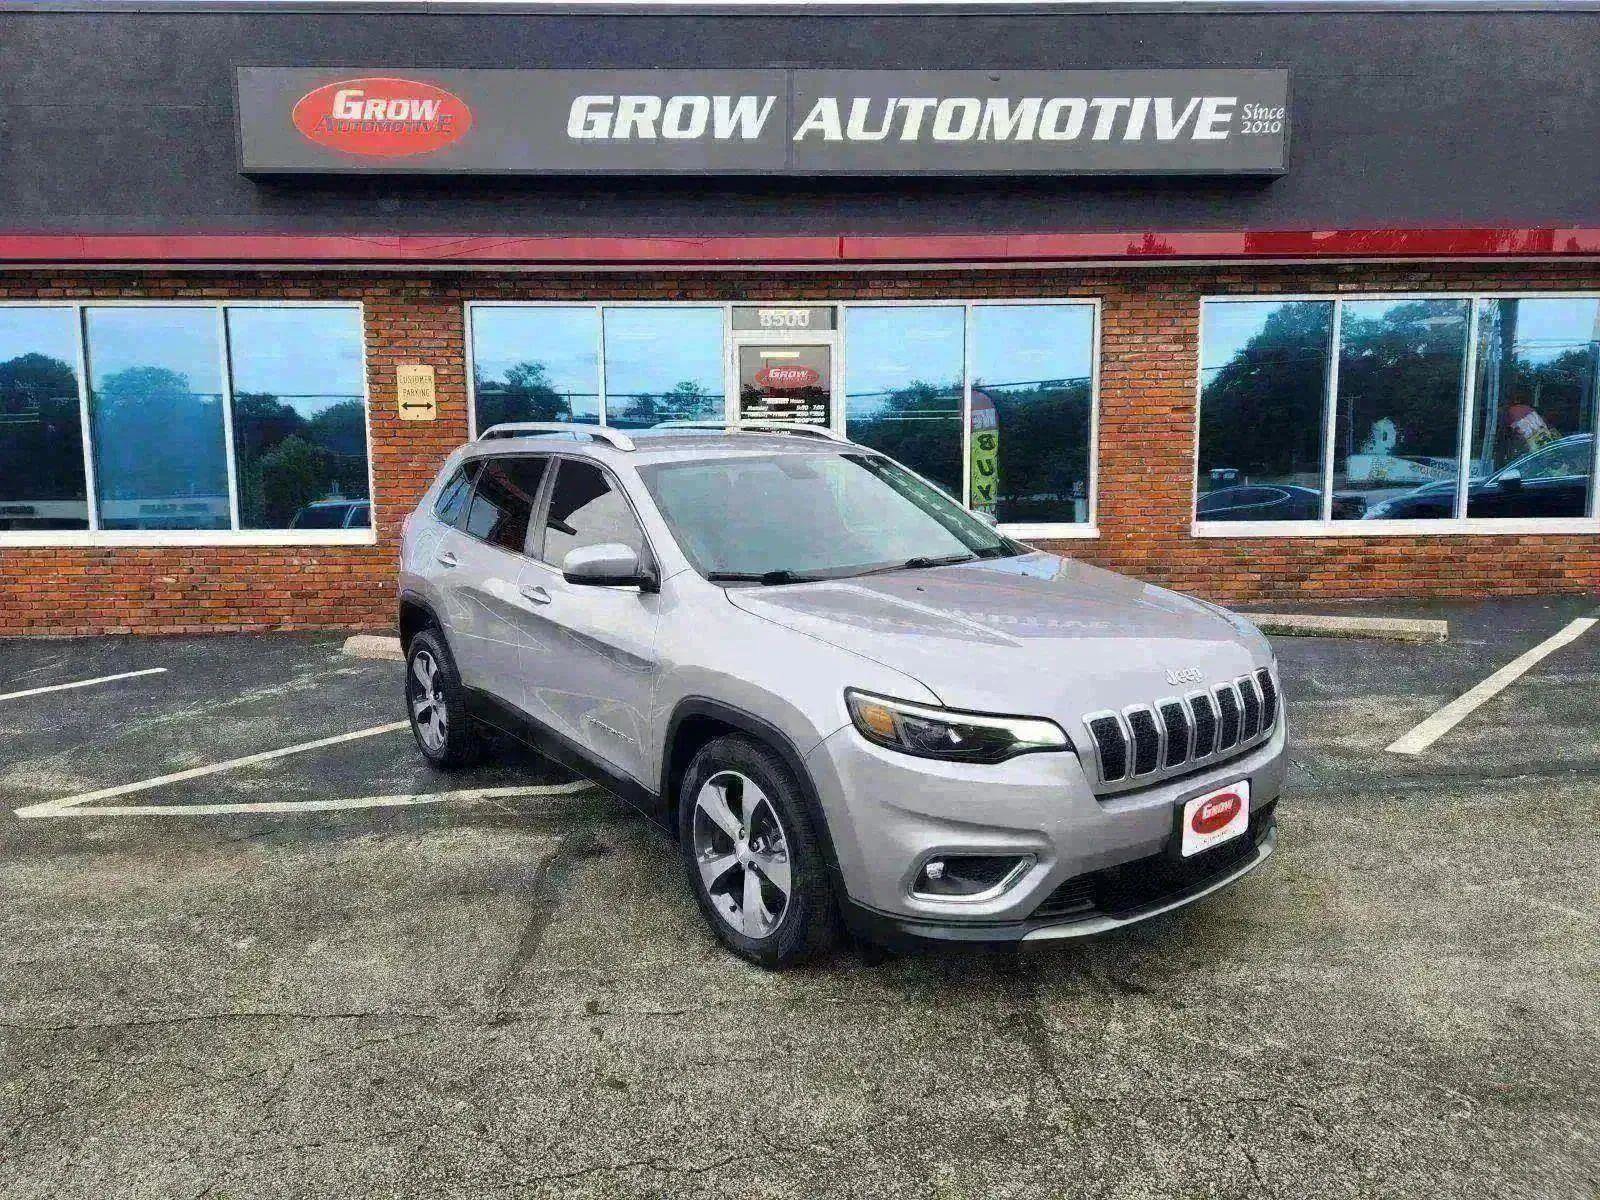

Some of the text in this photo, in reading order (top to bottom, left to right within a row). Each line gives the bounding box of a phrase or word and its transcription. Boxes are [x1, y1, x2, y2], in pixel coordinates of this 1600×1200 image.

[331, 89, 442, 121] GROW
[1241, 103, 1285, 120] Since
[312, 114, 456, 134] AUTOMOTIVE
[566, 95, 1238, 141] GROW AUTOMOTIVE
[1241, 120, 1282, 134] 2010
[399, 375, 433, 384] CUSTOMER
[768, 368, 808, 378] GROW
[402, 388, 430, 397] PARKING
[976, 433, 997, 501] BUY
[1162, 665, 1203, 686] Jeep
[1202, 799, 1235, 820] GROW
